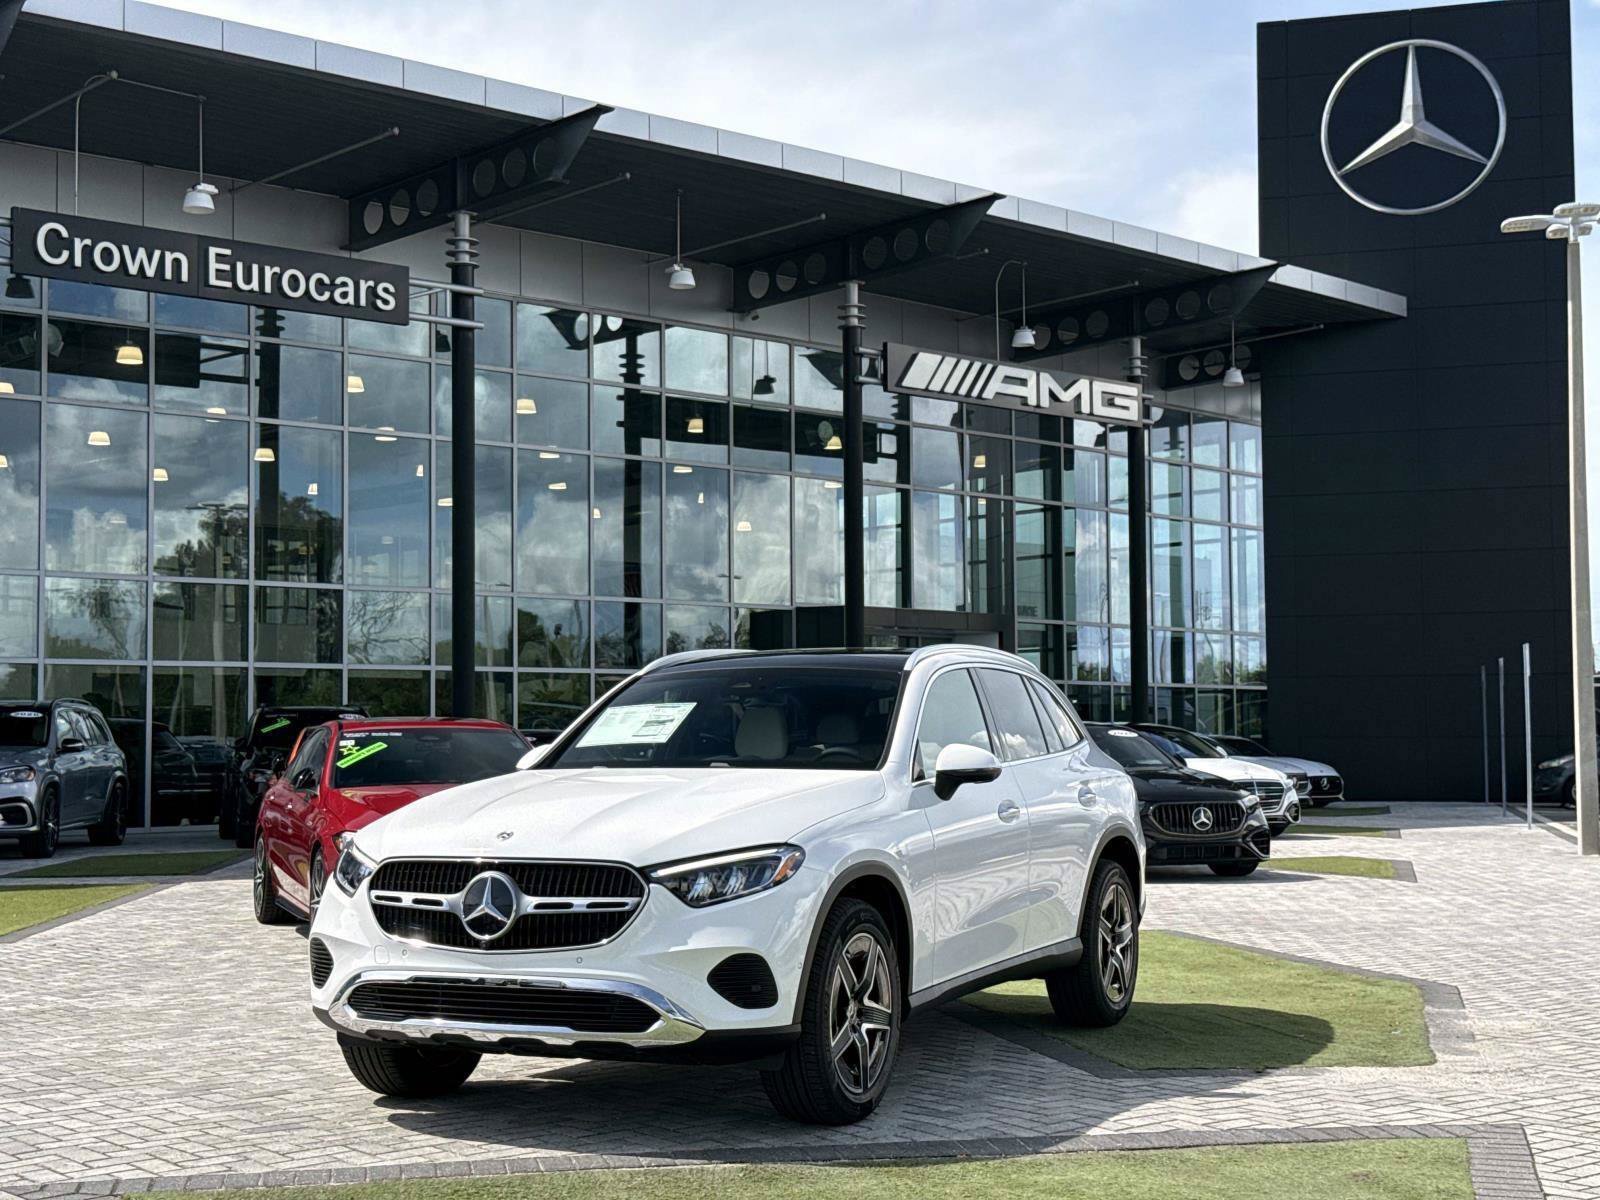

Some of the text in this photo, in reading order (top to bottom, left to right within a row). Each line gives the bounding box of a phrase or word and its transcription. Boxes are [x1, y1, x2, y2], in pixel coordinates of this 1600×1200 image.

[36, 222, 397, 311] Crown Eurocars
[981, 364, 1139, 421] AMG
